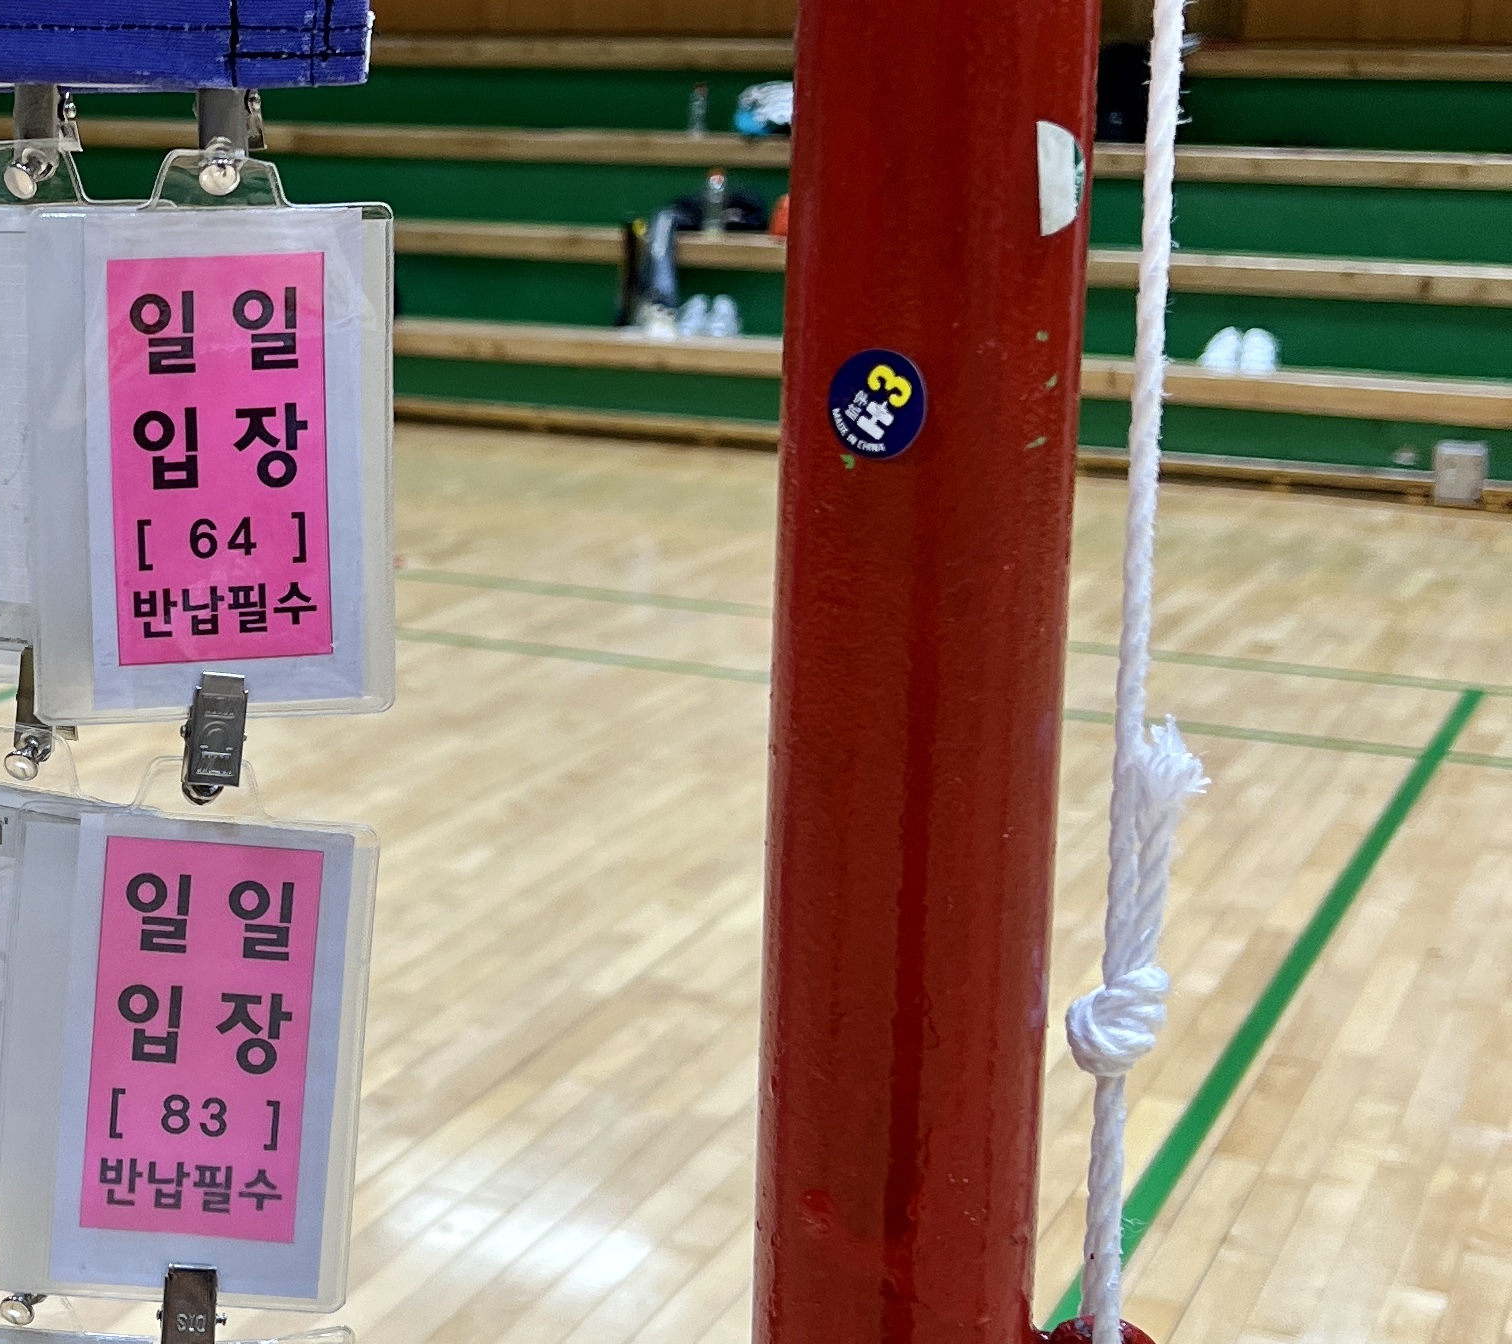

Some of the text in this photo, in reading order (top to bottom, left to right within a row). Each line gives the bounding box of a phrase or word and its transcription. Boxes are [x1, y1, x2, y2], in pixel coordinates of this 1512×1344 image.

[130, 287, 298, 375] 일 일
[133, 403, 308, 490] 입 장
[832, 408, 886, 452] MADE IN CHINA
[133, 582, 318, 638] 반납필수
[126, 873, 294, 961] 일 일
[118, 984, 292, 1074] 입 장
[99, 1158, 283, 1213] 반납필수
